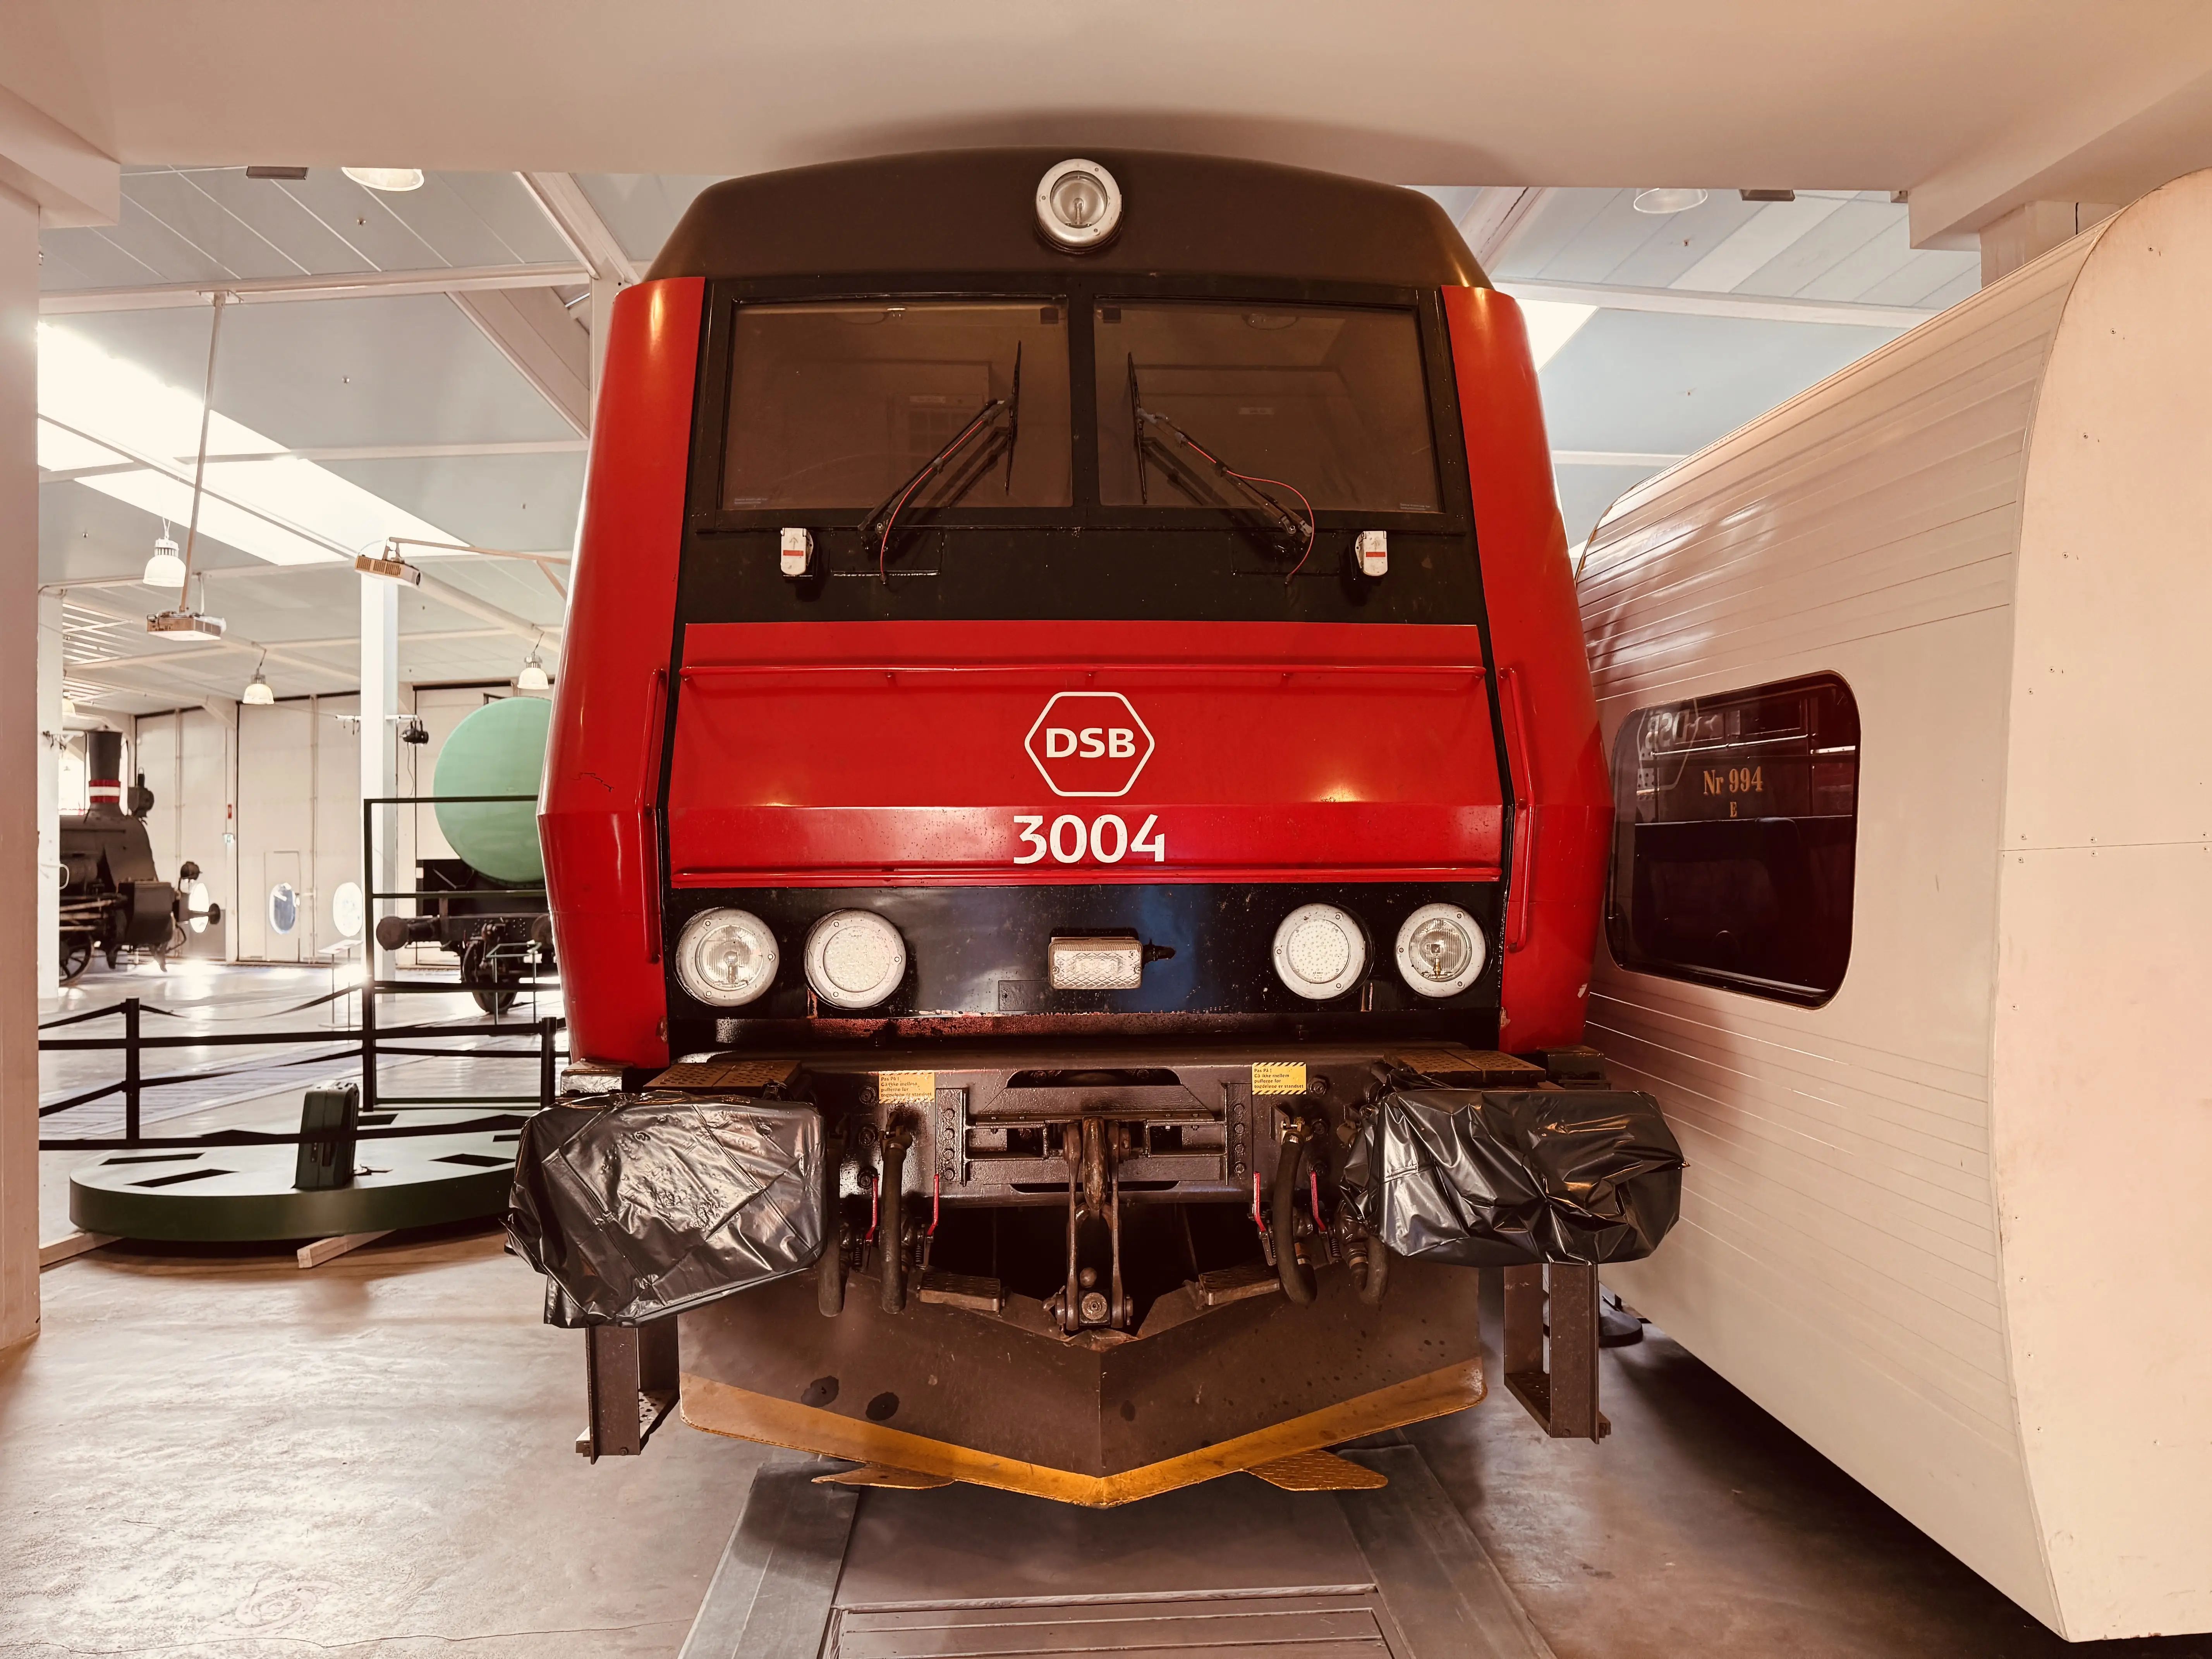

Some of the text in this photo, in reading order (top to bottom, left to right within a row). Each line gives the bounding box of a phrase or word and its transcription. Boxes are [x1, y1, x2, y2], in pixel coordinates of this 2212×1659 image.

[1046, 728, 1135, 757] DSB
[1704, 766, 1763, 795] Nr 994
[1730, 801, 1737, 817] E
[1013, 814, 1165, 864] 3004
